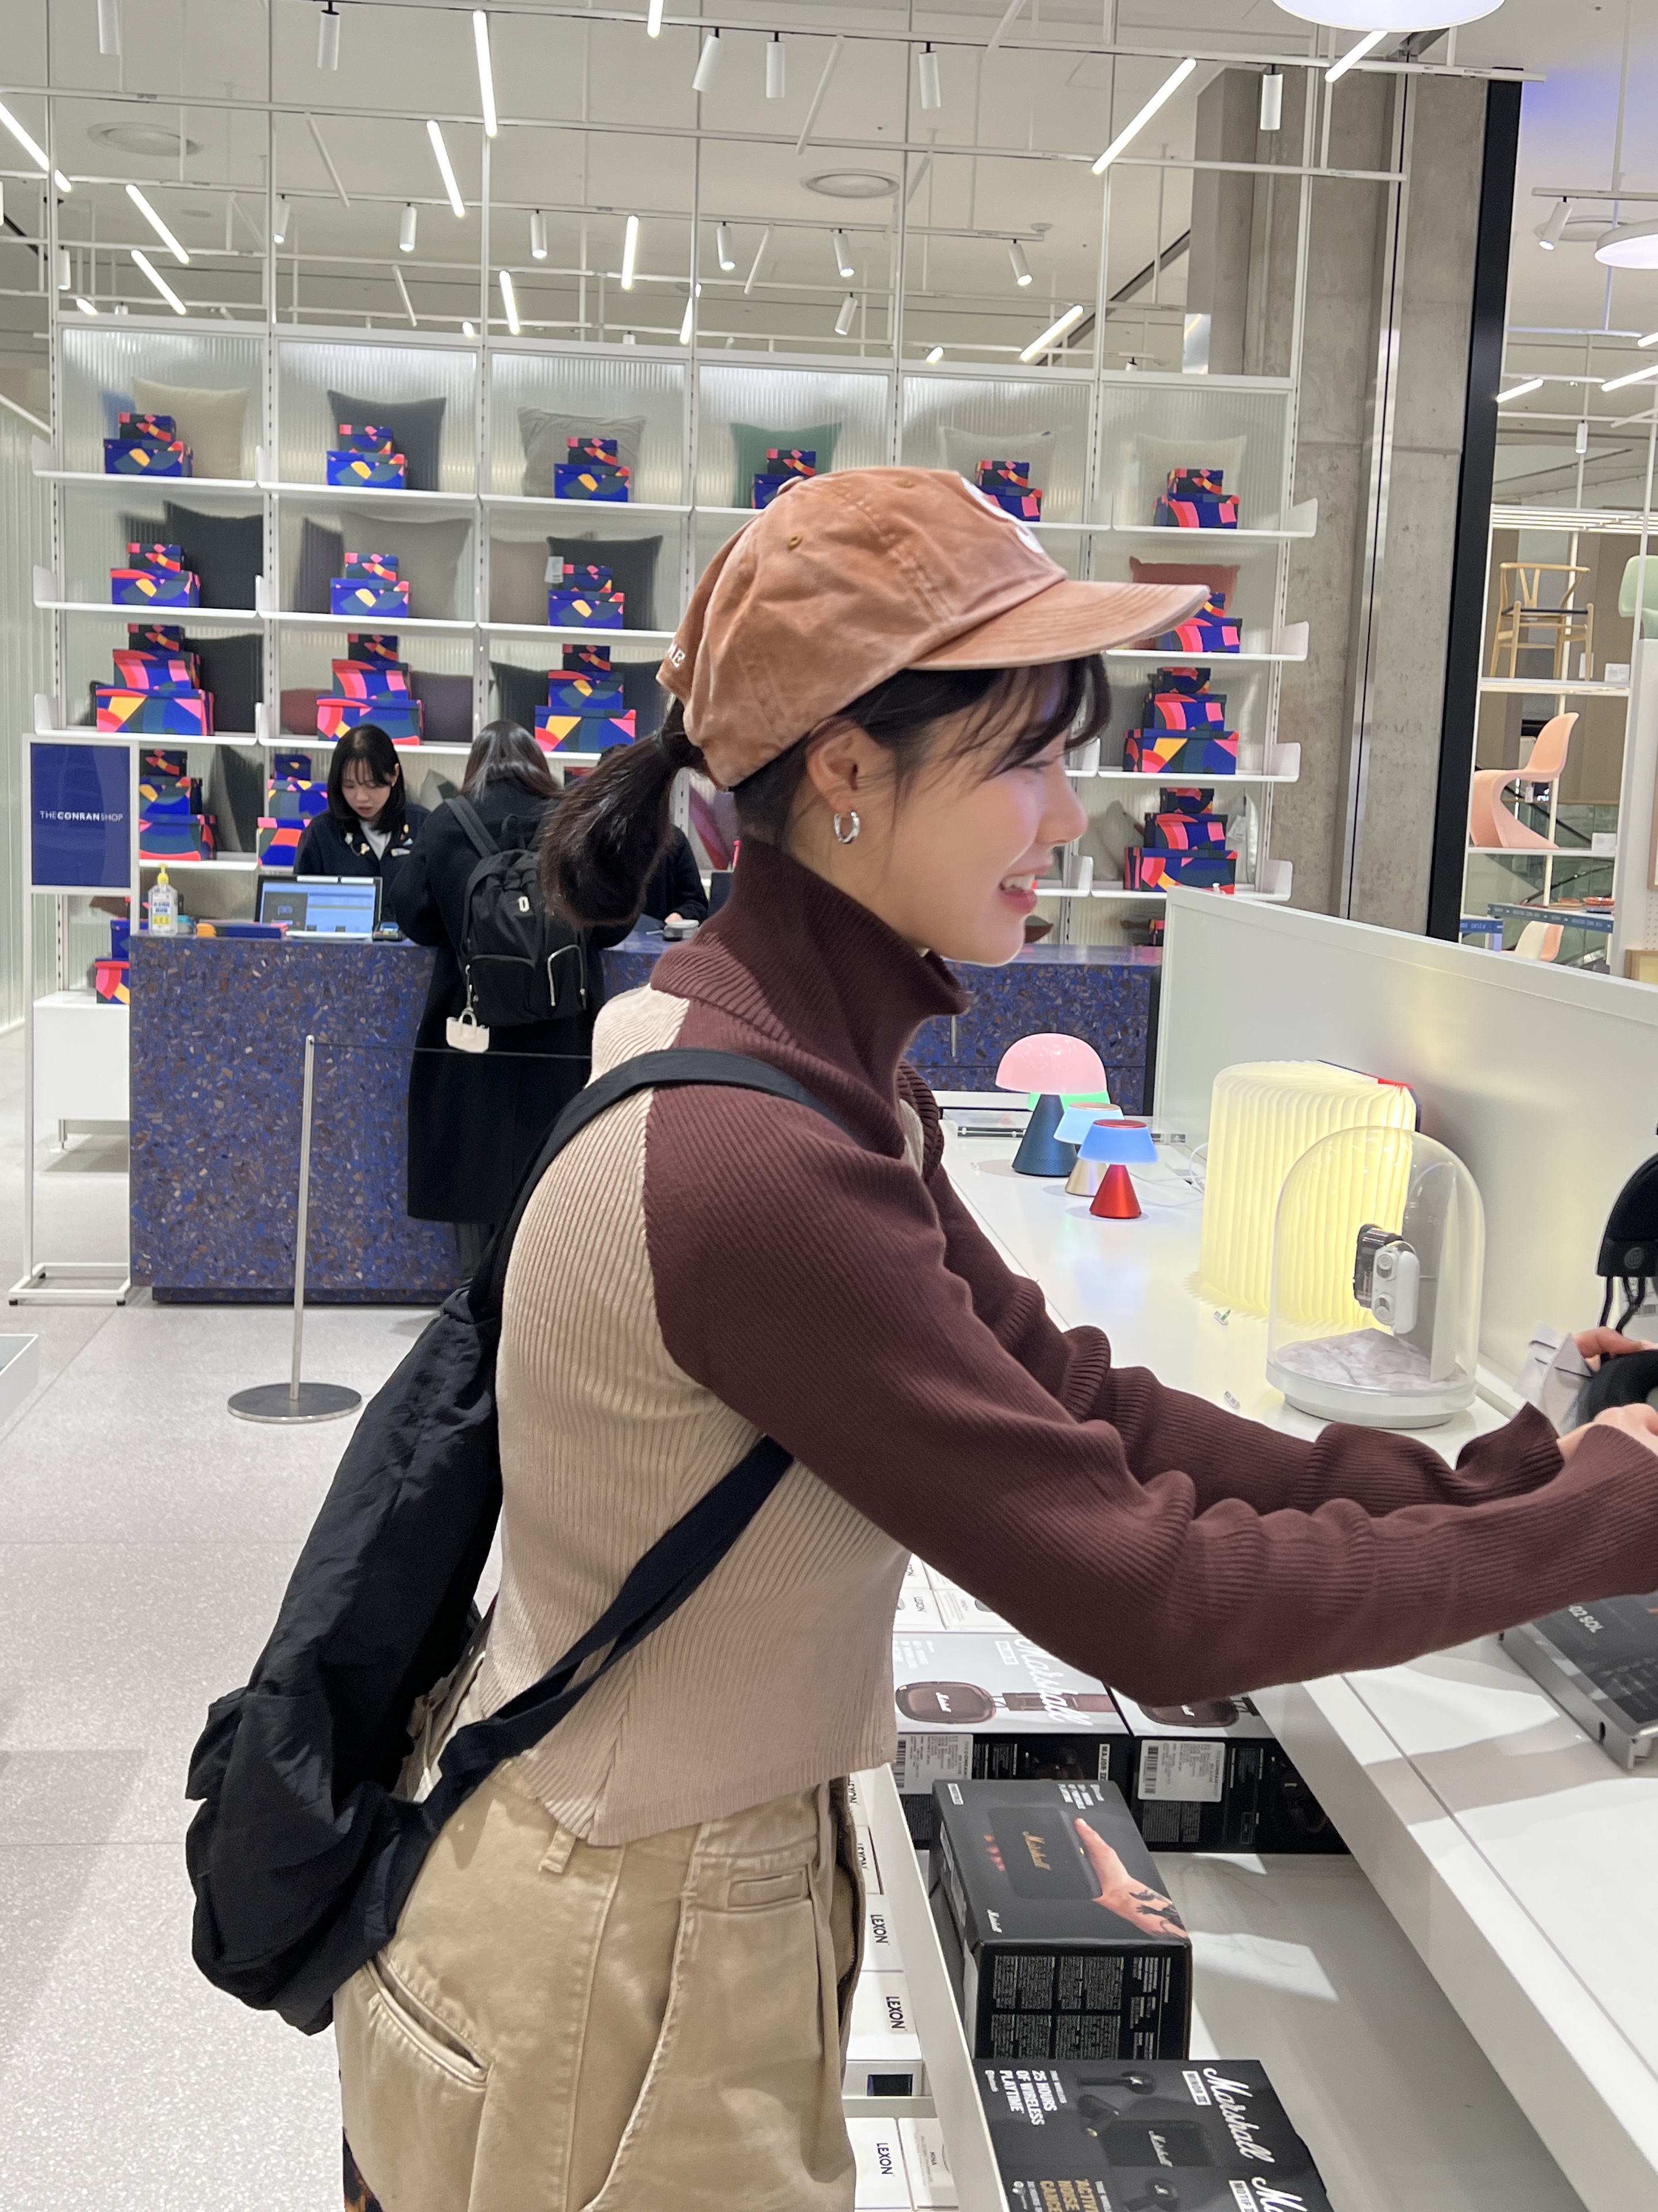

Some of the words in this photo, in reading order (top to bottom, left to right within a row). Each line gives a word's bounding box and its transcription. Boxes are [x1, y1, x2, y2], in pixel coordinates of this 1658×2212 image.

[40, 811, 56, 820] THE
[57, 811, 99, 821] CONRAN
[100, 812, 123, 822] SHOP
[1014, 1639, 1093, 1726] Marshall
[870, 1914, 889, 1944] LEXON
[886, 1996, 906, 2029] LEXON
[999, 2069, 1024, 2113] PLAYTIME
[1015, 2070, 1031, 2082] OF
[1031, 2069, 1047, 2082] 25
[1019, 2083, 1045, 2126] WIRELESS
[1036, 2083, 1057, 2111] HOURS
[1203, 2068, 1275, 2164] Marshall
[877, 2142, 893, 2175] LEXON
